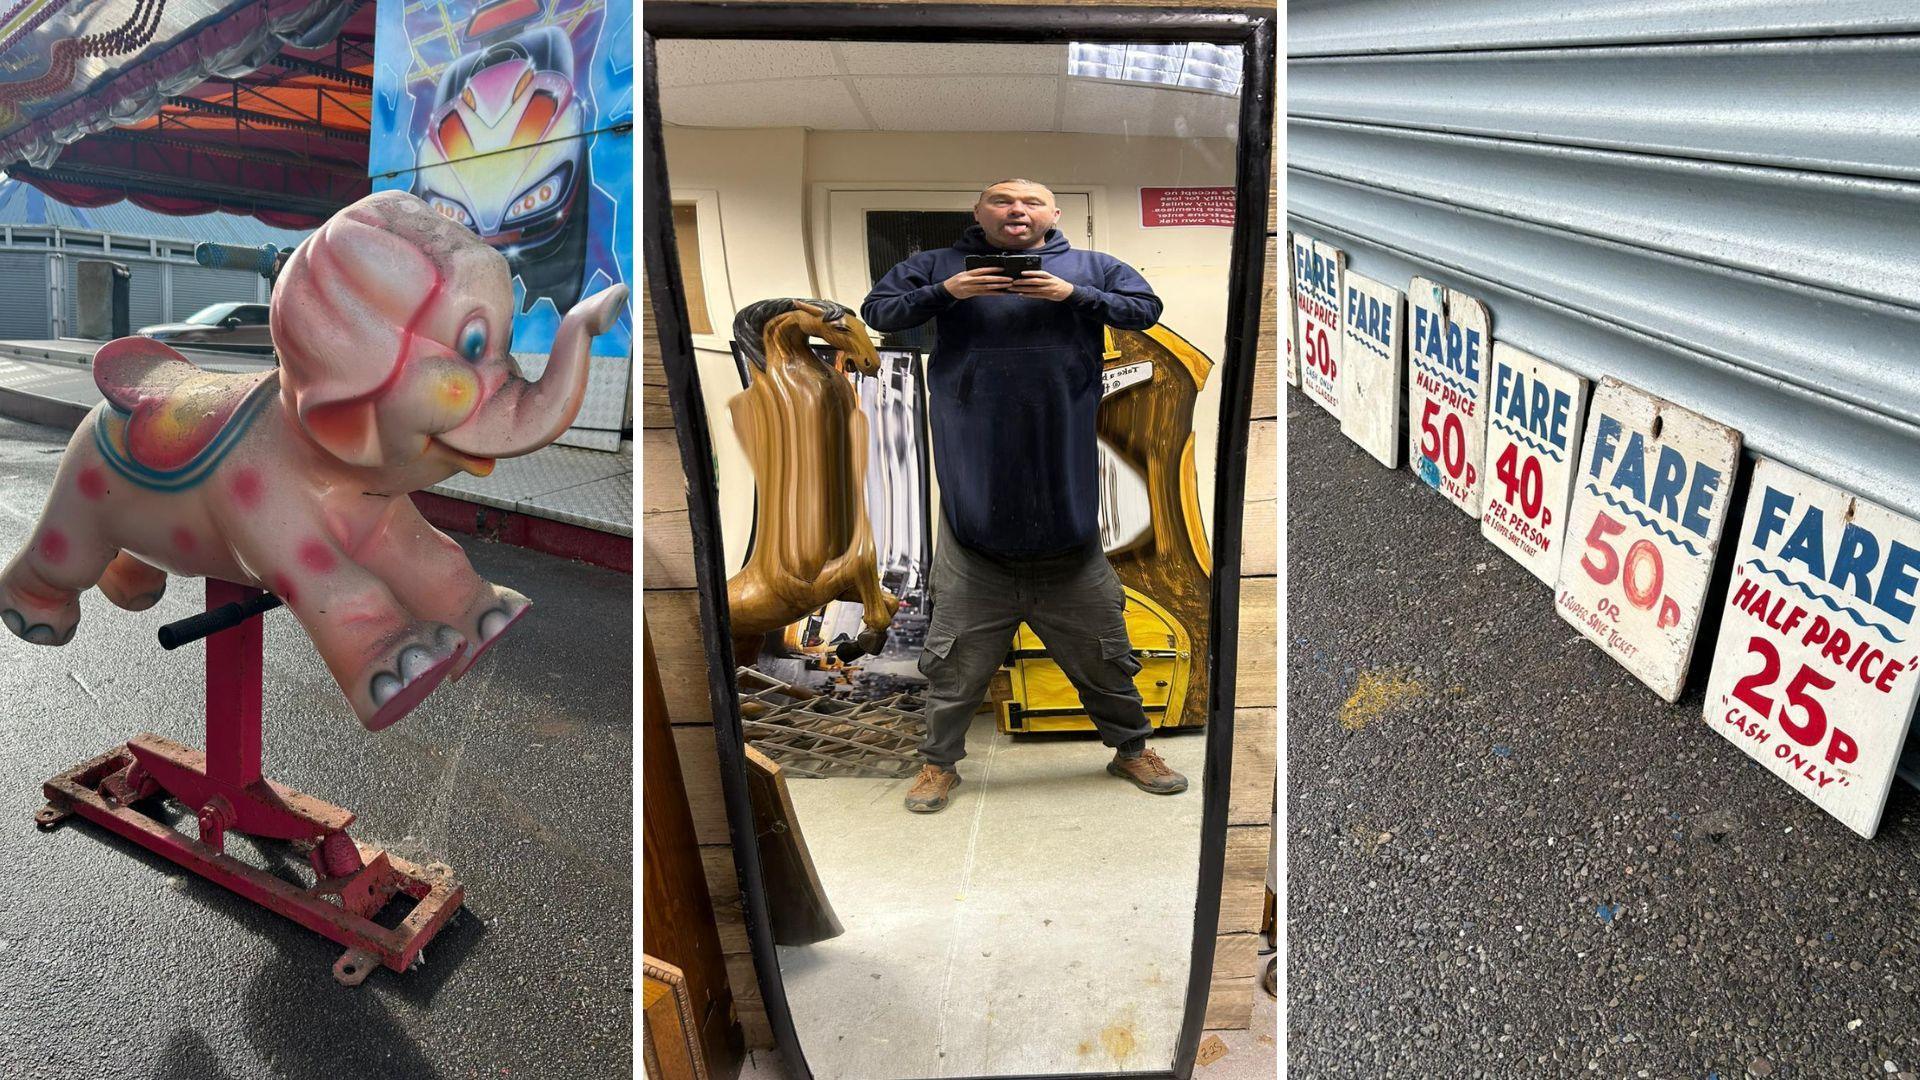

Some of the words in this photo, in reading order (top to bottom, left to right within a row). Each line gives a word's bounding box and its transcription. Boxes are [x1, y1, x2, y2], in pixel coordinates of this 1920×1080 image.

[1296, 243, 1337, 298] FARE
[1298, 291, 1314, 316] HALF
[1314, 302, 1337, 331] PRICE
[1348, 286, 1392, 347] FARE
[1415, 304, 1480, 383] FARE
[1416, 371, 1441, 395] HALF
[1442, 385, 1475, 417] PRICE
[1495, 362, 1571, 451] FARE
[1589, 413, 1722, 539] FARE
[1483, 513, 1491, 525] OR
[1520, 540, 1537, 558] TICKET
[1489, 499, 1508, 521] PER
[1509, 513, 1551, 552] PERSON
[1752, 485, 1920, 625] FARE
[1564, 596, 1588, 621] SUPER
[1587, 613, 1609, 636] SAVE
[1608, 629, 1639, 659] TICKET
[1597, 597, 1620, 623] OR
